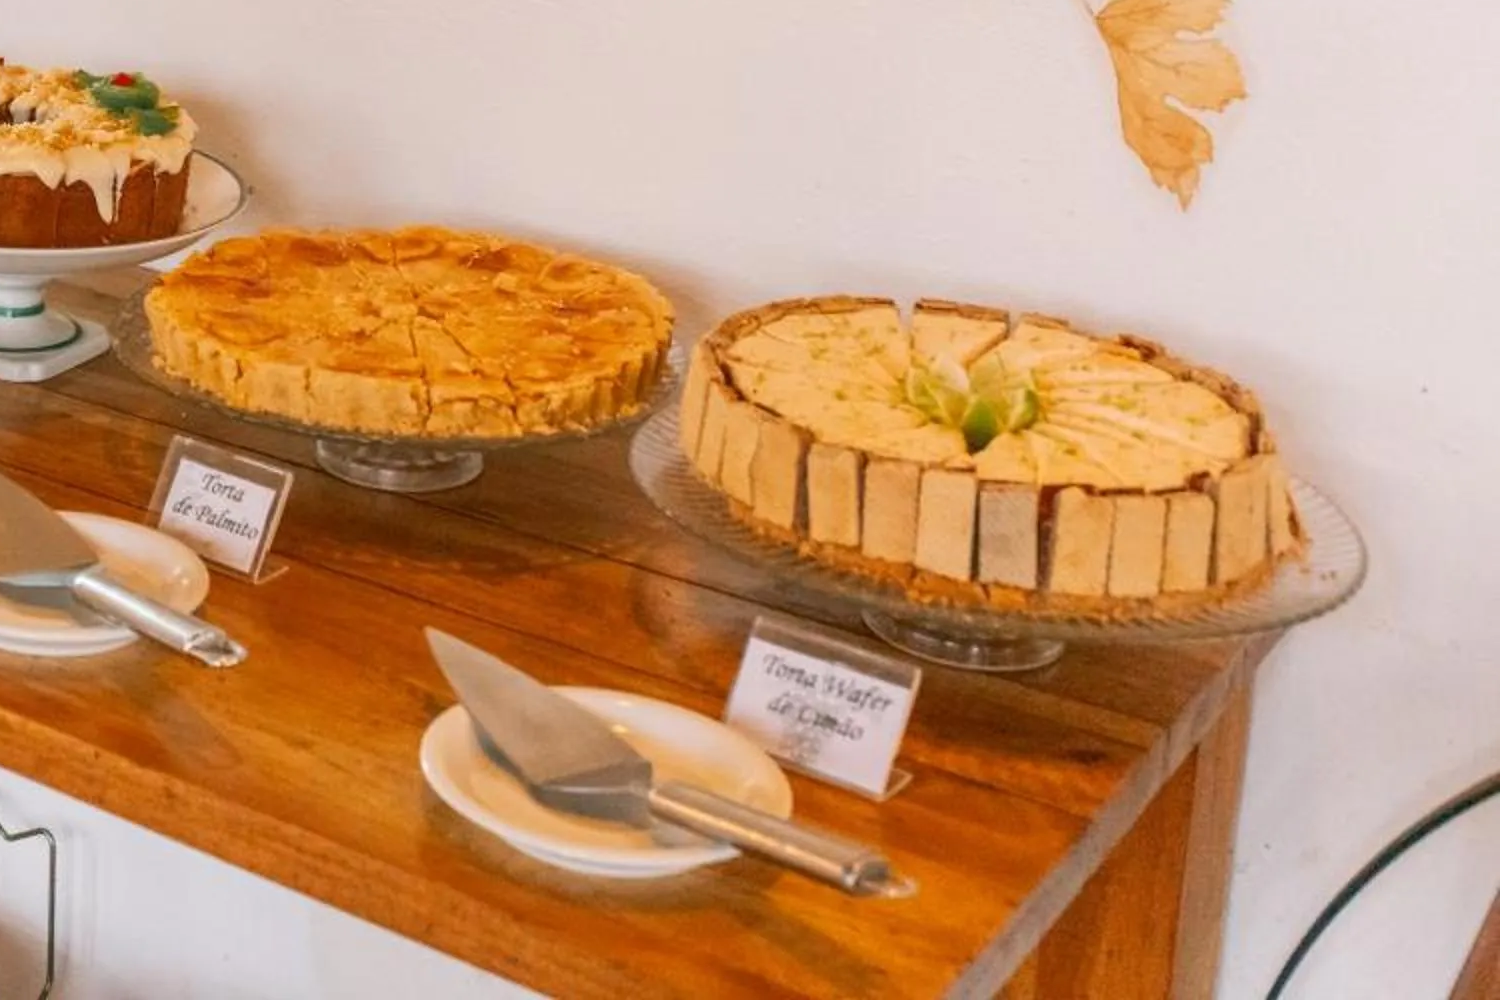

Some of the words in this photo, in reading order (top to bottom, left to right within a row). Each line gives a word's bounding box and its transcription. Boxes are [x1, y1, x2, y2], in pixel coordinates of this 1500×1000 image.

[201, 473, 245, 502] Torta
[171, 495, 194, 516] de
[194, 503, 260, 540] Palmito
[763, 653, 818, 688] Torta
[822, 674, 893, 712] Wafer
[766, 691, 794, 715] de
